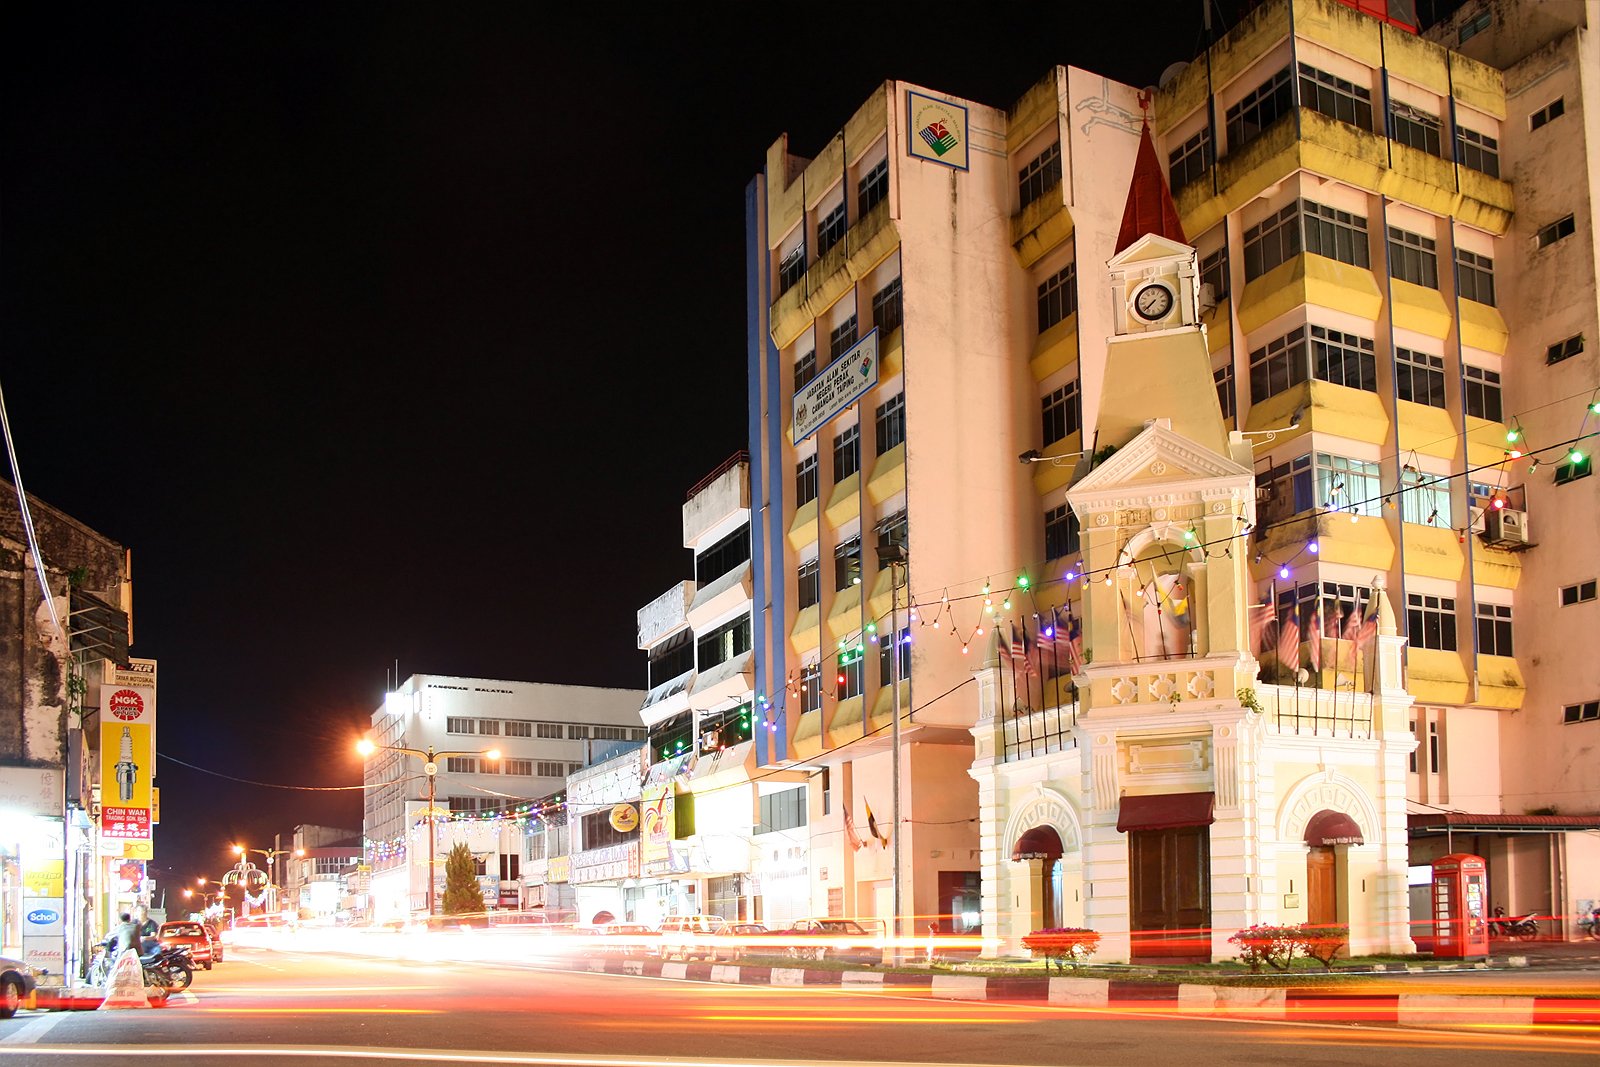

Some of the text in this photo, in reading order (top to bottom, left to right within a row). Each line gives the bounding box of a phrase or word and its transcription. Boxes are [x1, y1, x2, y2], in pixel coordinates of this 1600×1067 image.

[807, 349, 861, 400] JABATAN ALAM SEKITAR
[811, 375, 855, 415] CAWANGAN TAIPING
[816, 369, 849, 401] NEGERI PERAK
[115, 696, 138, 705] NGK
[30, 912, 57, 921] Scholl
[28, 949, 62, 957] Bata
